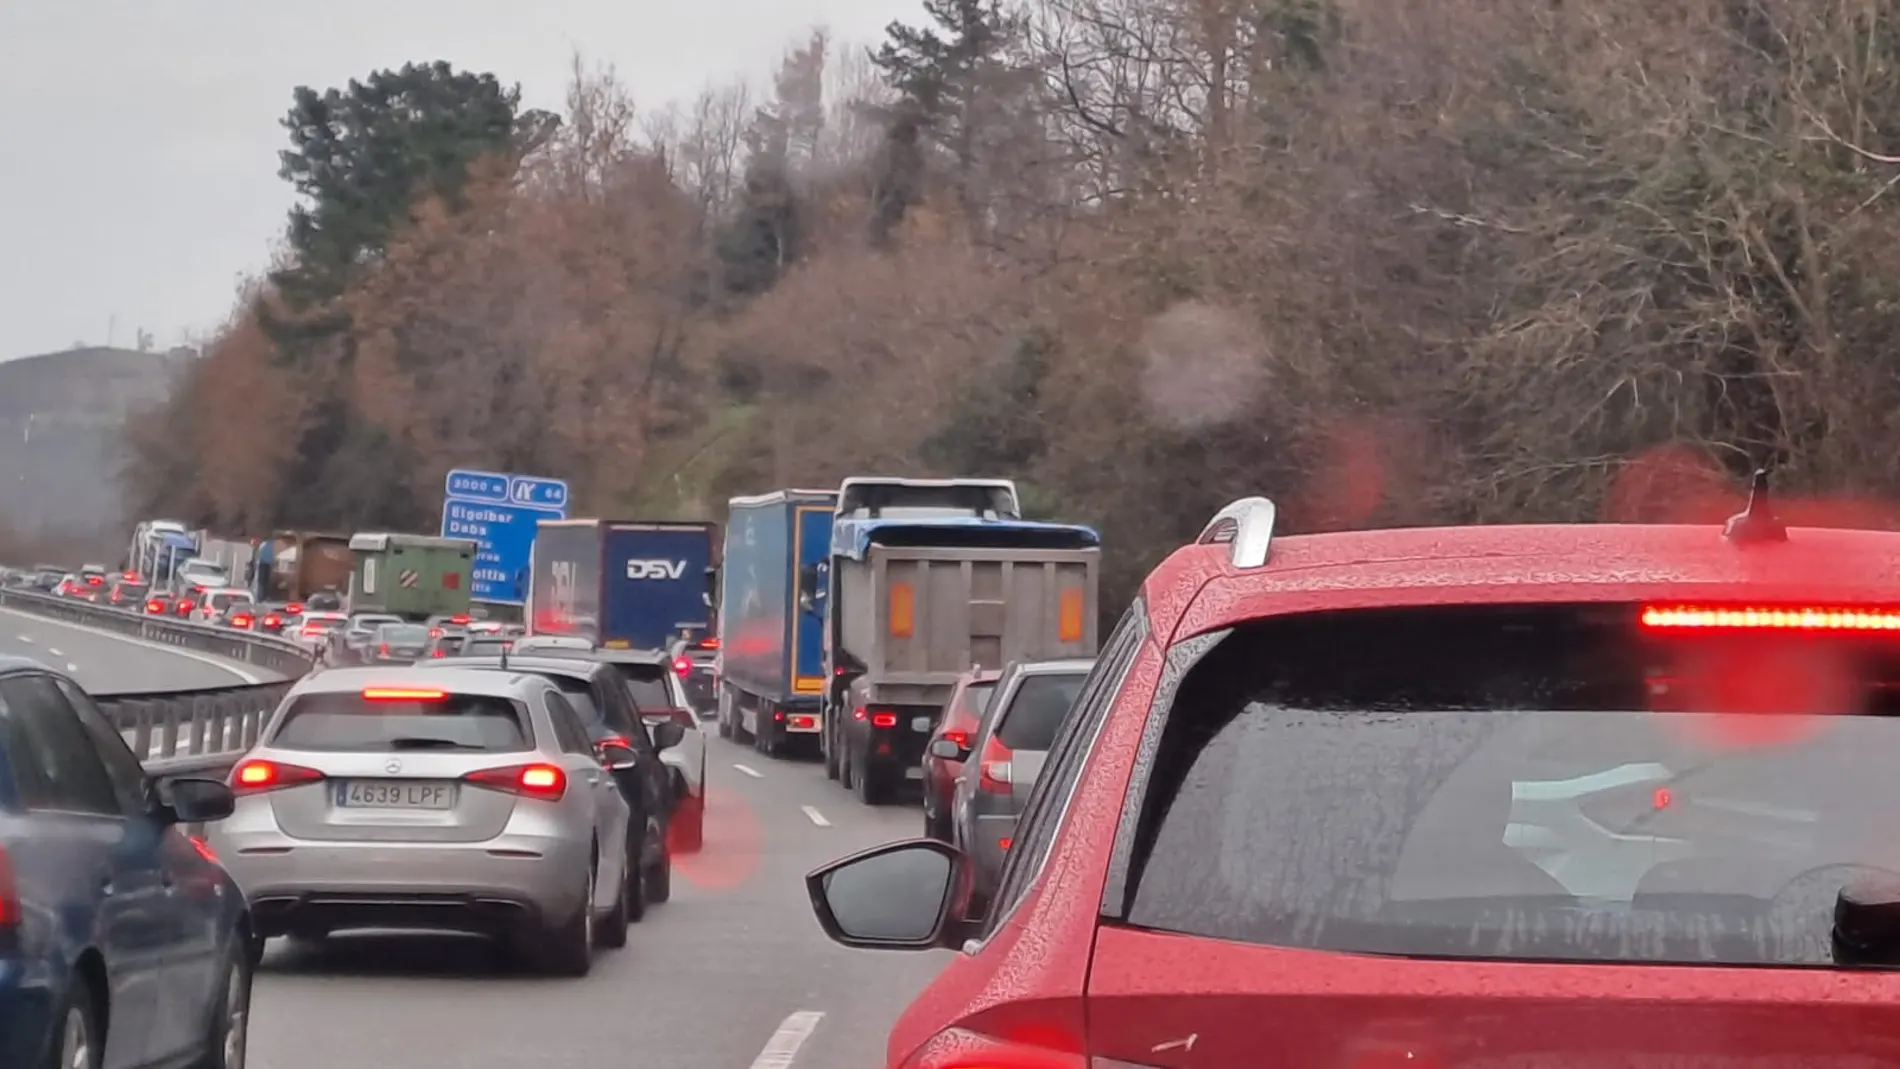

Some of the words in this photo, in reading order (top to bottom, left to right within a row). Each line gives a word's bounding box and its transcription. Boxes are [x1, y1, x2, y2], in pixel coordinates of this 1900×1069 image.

[453, 478, 488, 492] 3000
[451, 504, 514, 523] Elgoibar
[627, 558, 688, 579] DSV
[350, 786, 401, 804] 4639
[407, 787, 446, 805] LPF
